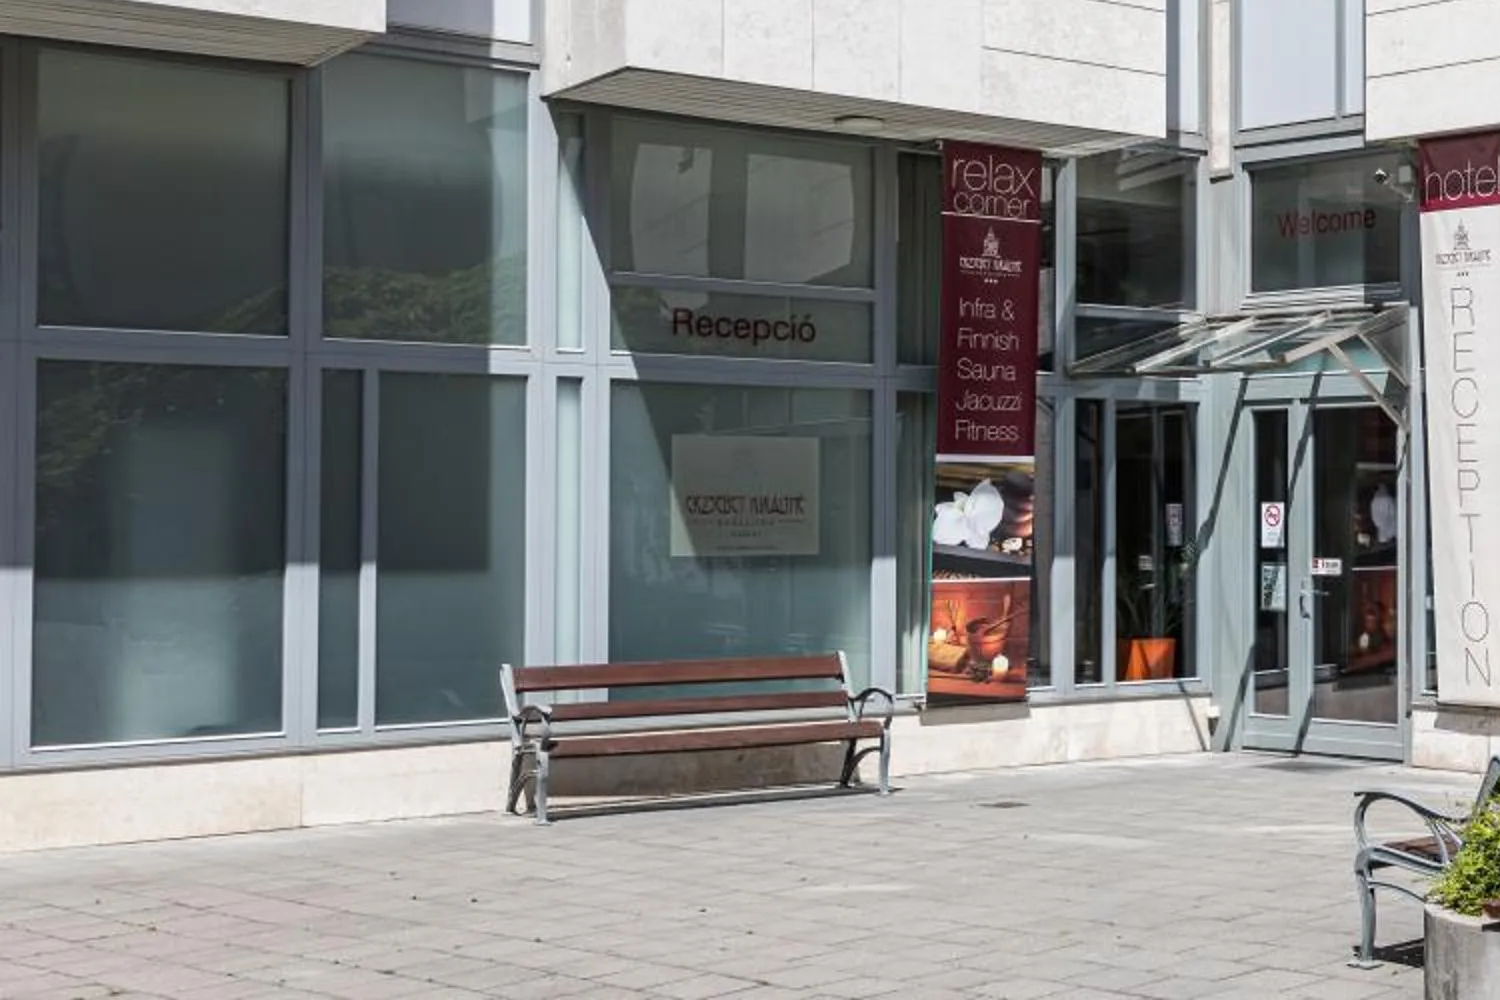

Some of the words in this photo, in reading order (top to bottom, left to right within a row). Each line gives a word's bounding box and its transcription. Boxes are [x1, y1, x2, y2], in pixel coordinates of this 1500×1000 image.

[952, 154, 1036, 198] relax
[1424, 155, 1500, 205] hotel
[953, 191, 1031, 218] corner
[1276, 208, 1376, 237] Welcome
[959, 297, 996, 320] Infra
[1001, 299, 1015, 321] &
[672, 307, 816, 346] Recepció
[957, 328, 1019, 351] Finnish
[957, 358, 1017, 381] Sauna
[955, 391, 1023, 412] Jacuzzi
[955, 420, 1019, 442] Fitness
[1450, 286, 1491, 687] RECEPTION
